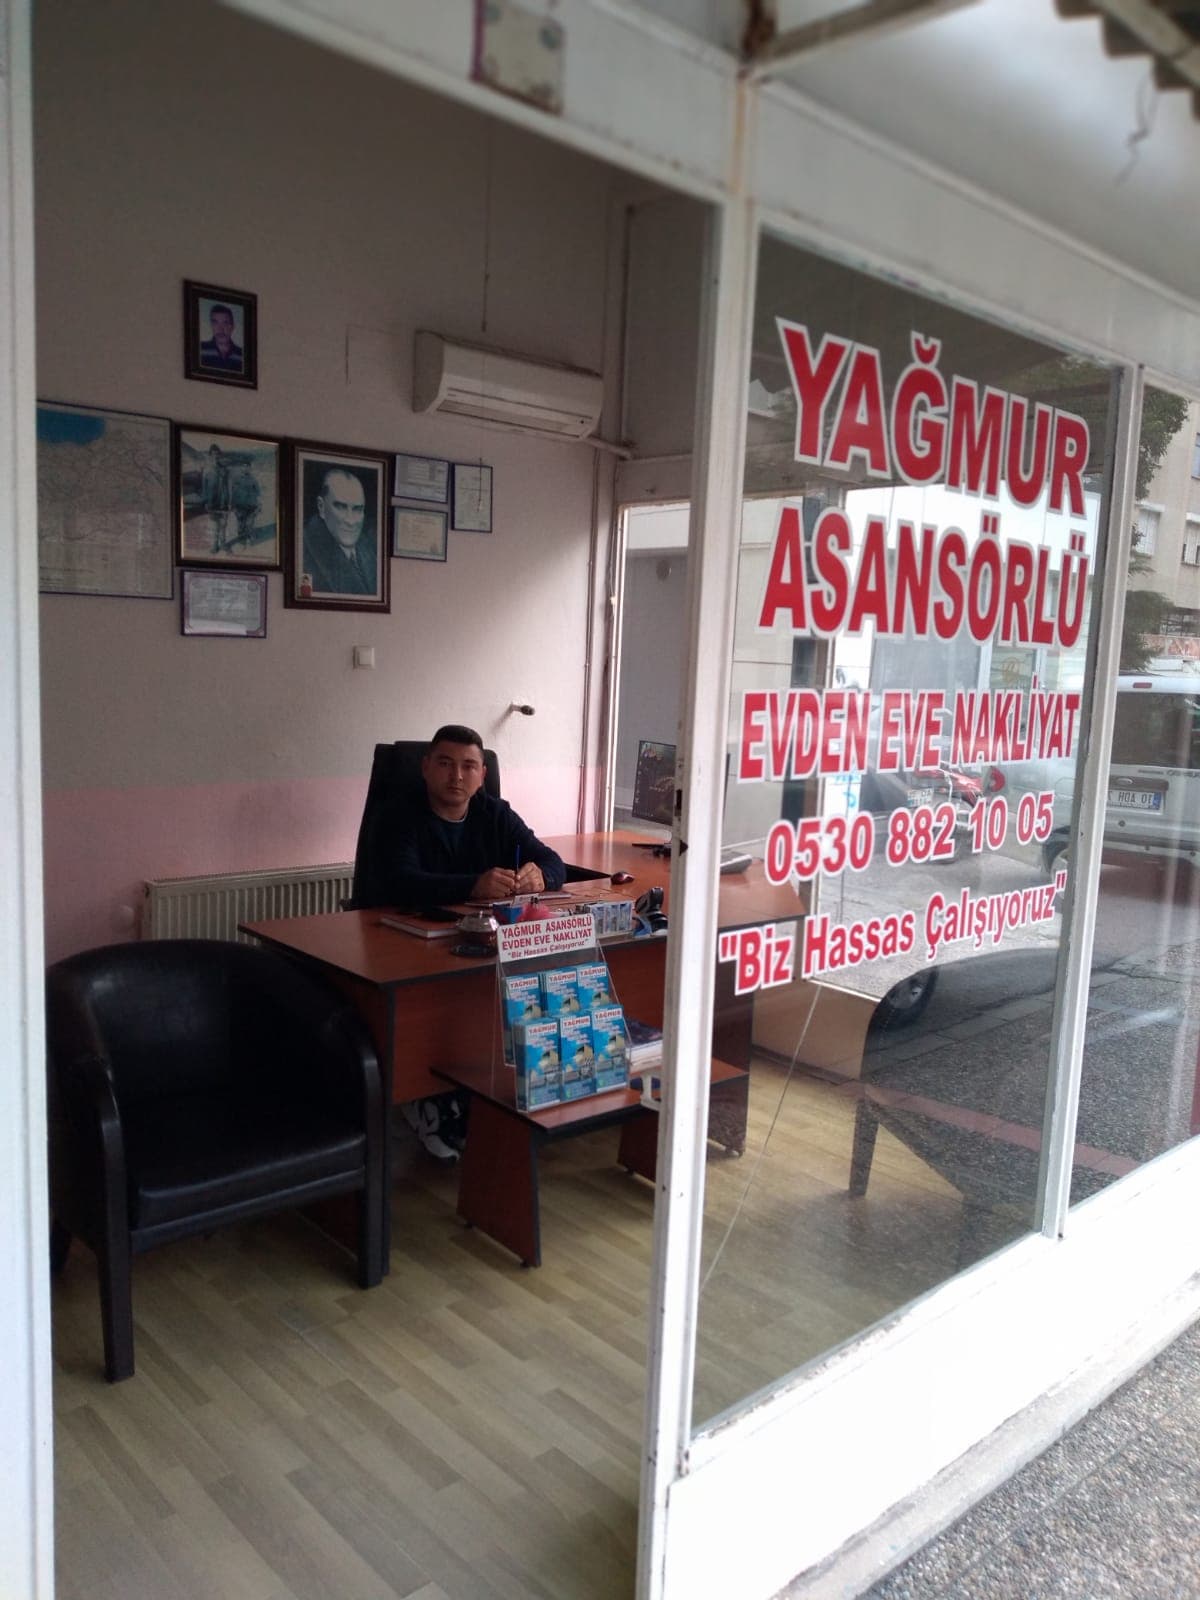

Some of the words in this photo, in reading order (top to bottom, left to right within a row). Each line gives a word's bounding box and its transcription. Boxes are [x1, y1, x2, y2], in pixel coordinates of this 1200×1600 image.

[779, 321, 1089, 517] YAĞMUR
[757, 505, 1089, 649] ASANSÖRLÜ
[738, 690, 870, 782] EVDEN
[878, 690, 945, 772] EVE
[951, 674, 1082, 765] NAKLİYAT
[765, 813, 873, 885] 0530
[886, 804, 955, 866] 882
[970, 797, 1007, 852] 10
[1017, 792, 1054, 843] 05
[502, 937, 531, 951] EVDEN
[534, 934, 552, 946] EVE
[719, 925, 793, 993] "Biz
[802, 914, 916, 976] Hassas
[924, 872, 1068, 960] Çalışıyoruz"
